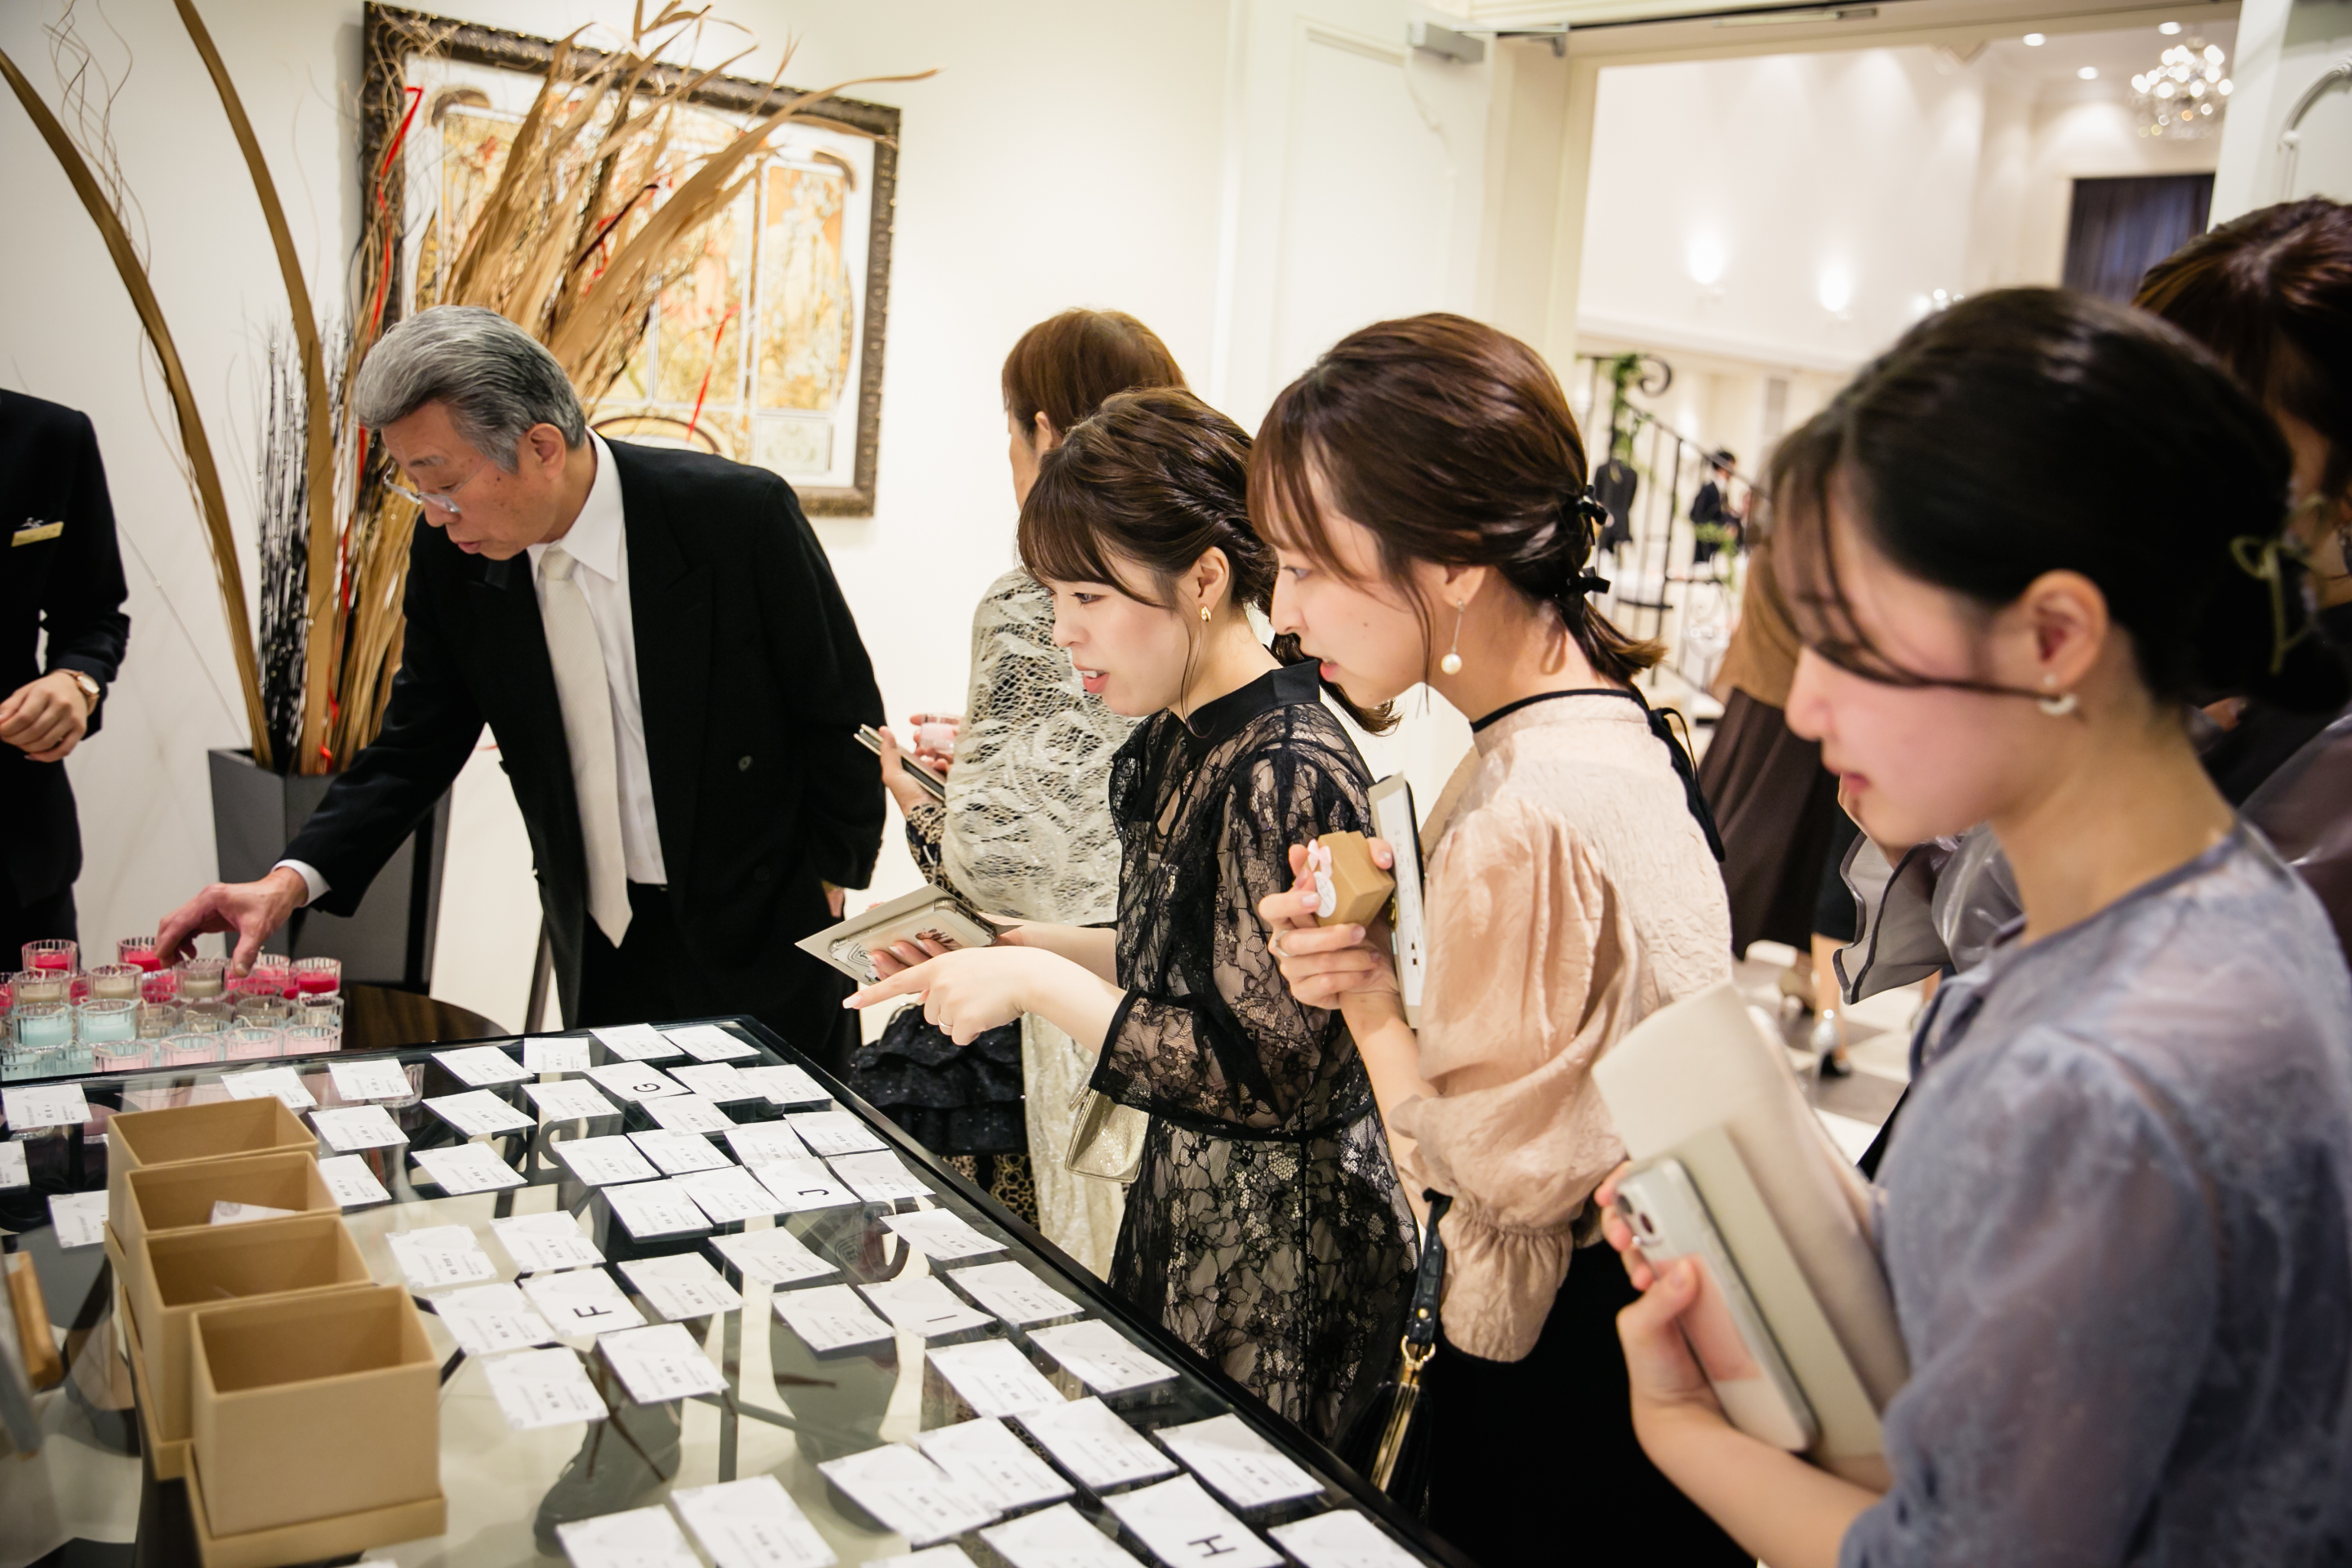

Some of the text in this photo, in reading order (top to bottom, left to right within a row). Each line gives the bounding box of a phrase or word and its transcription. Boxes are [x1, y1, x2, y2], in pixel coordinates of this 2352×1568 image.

[633, 1083, 661, 1092] G
[572, 1305, 613, 1317] F
[1187, 1534, 1237, 1557] H
